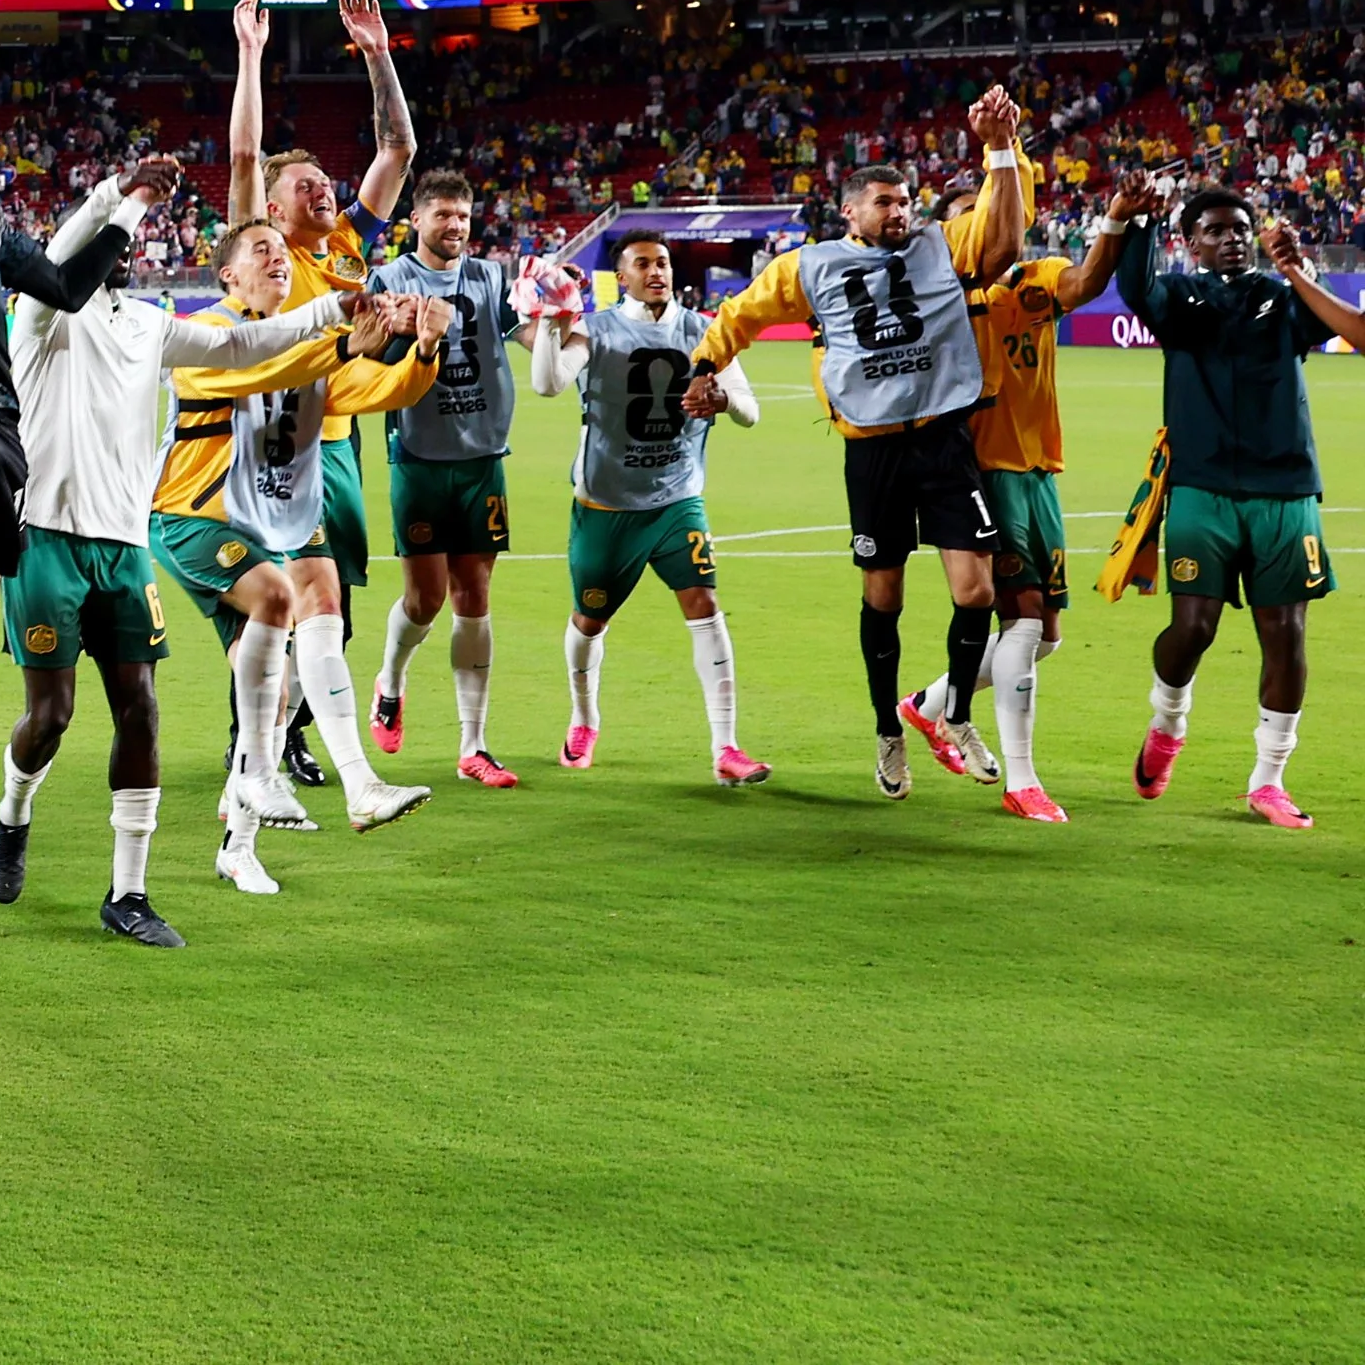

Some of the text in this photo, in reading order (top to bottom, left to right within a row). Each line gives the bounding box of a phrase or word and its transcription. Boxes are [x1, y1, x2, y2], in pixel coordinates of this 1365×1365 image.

[1, 24, 42, 34] AREA
[875, 325, 907, 341] FIFA
[907, 345, 931, 357] CUP
[1003, 332, 1038, 369] 26
[446, 366, 473, 379] FIFA
[863, 357, 932, 380] 2026
[438, 398, 487, 415] 2026
[644, 423, 672, 434] FIFA
[625, 444, 664, 454] WORLD
[624, 451, 681, 468] 2026
[486, 496, 508, 531] 2
[971, 490, 991, 526] 1
[1303, 535, 1321, 575] 9
[1048, 548, 1066, 585] 2
[145, 582, 165, 630] 6
